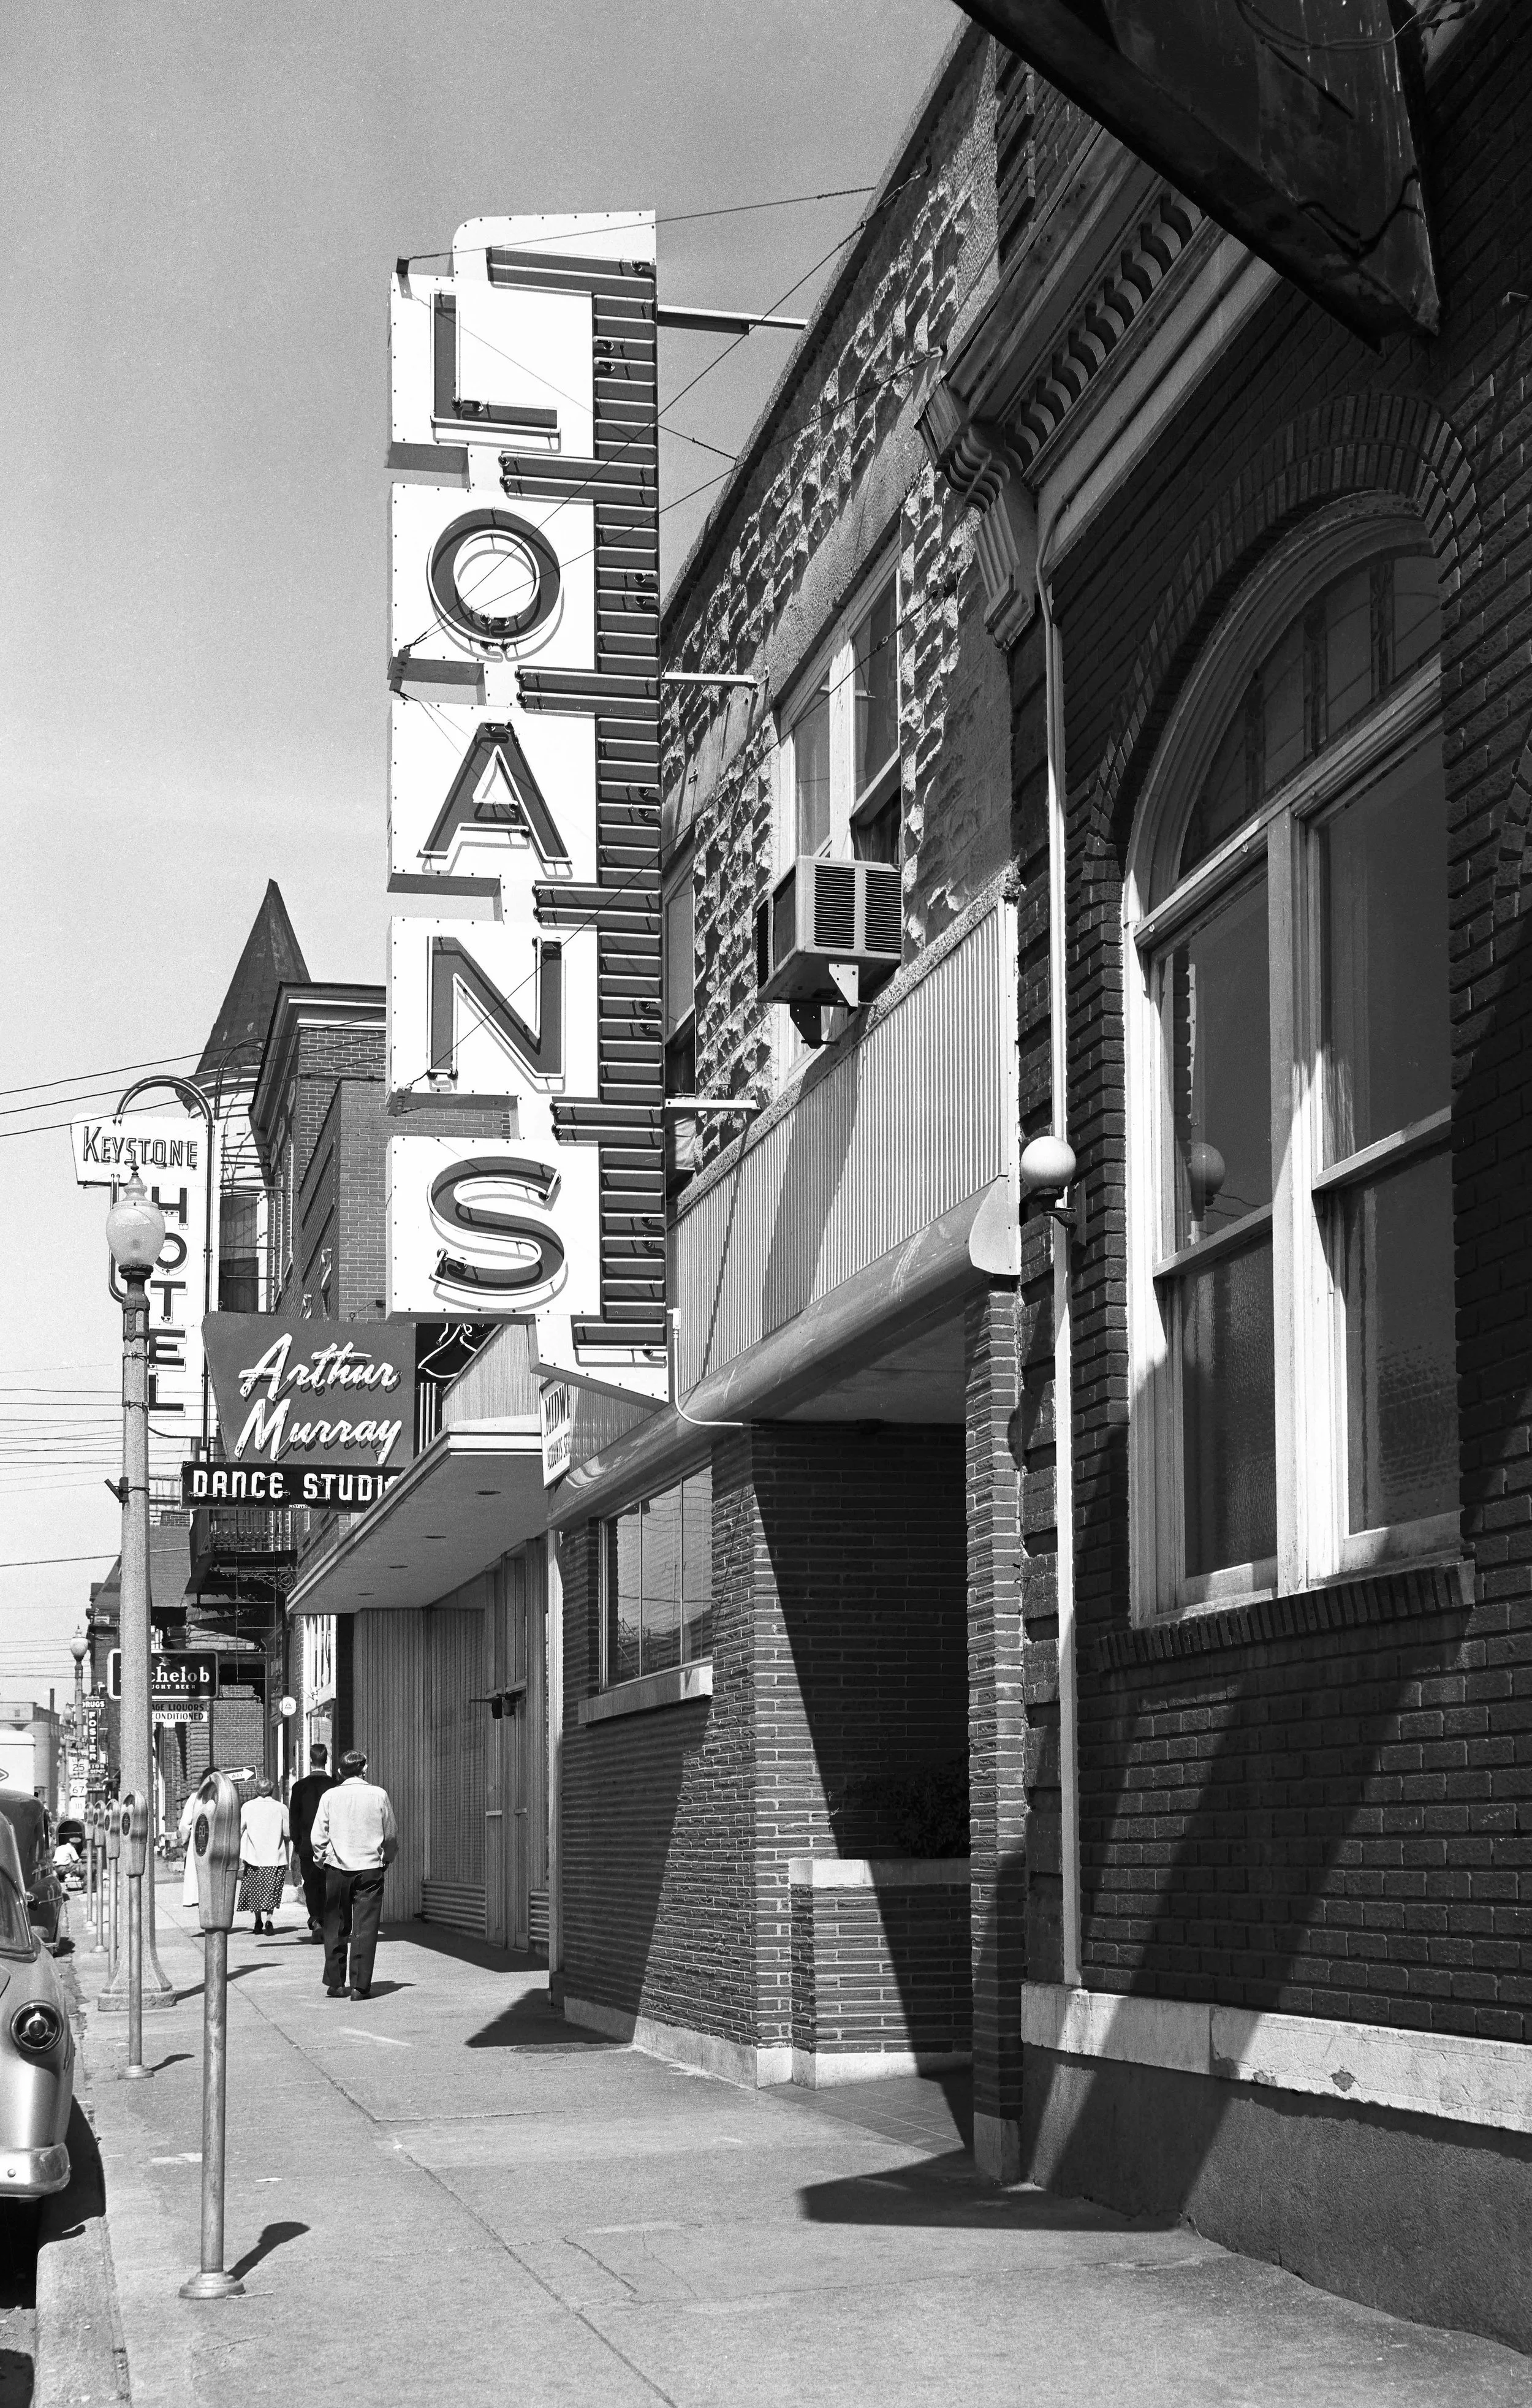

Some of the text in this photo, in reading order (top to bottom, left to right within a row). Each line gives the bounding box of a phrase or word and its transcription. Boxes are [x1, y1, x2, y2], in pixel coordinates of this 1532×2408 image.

[417, 291, 570, 1308] LOANS
[148, 1186, 187, 1412] HOTEL
[238, 1333, 398, 1402] Arthur
[234, 1399, 403, 1465] Murray
[193, 1470, 400, 1501] DANCE STUDI
[72, 1763, 85, 1772] 25
[88, 1711, 97, 1760] FOSTER
